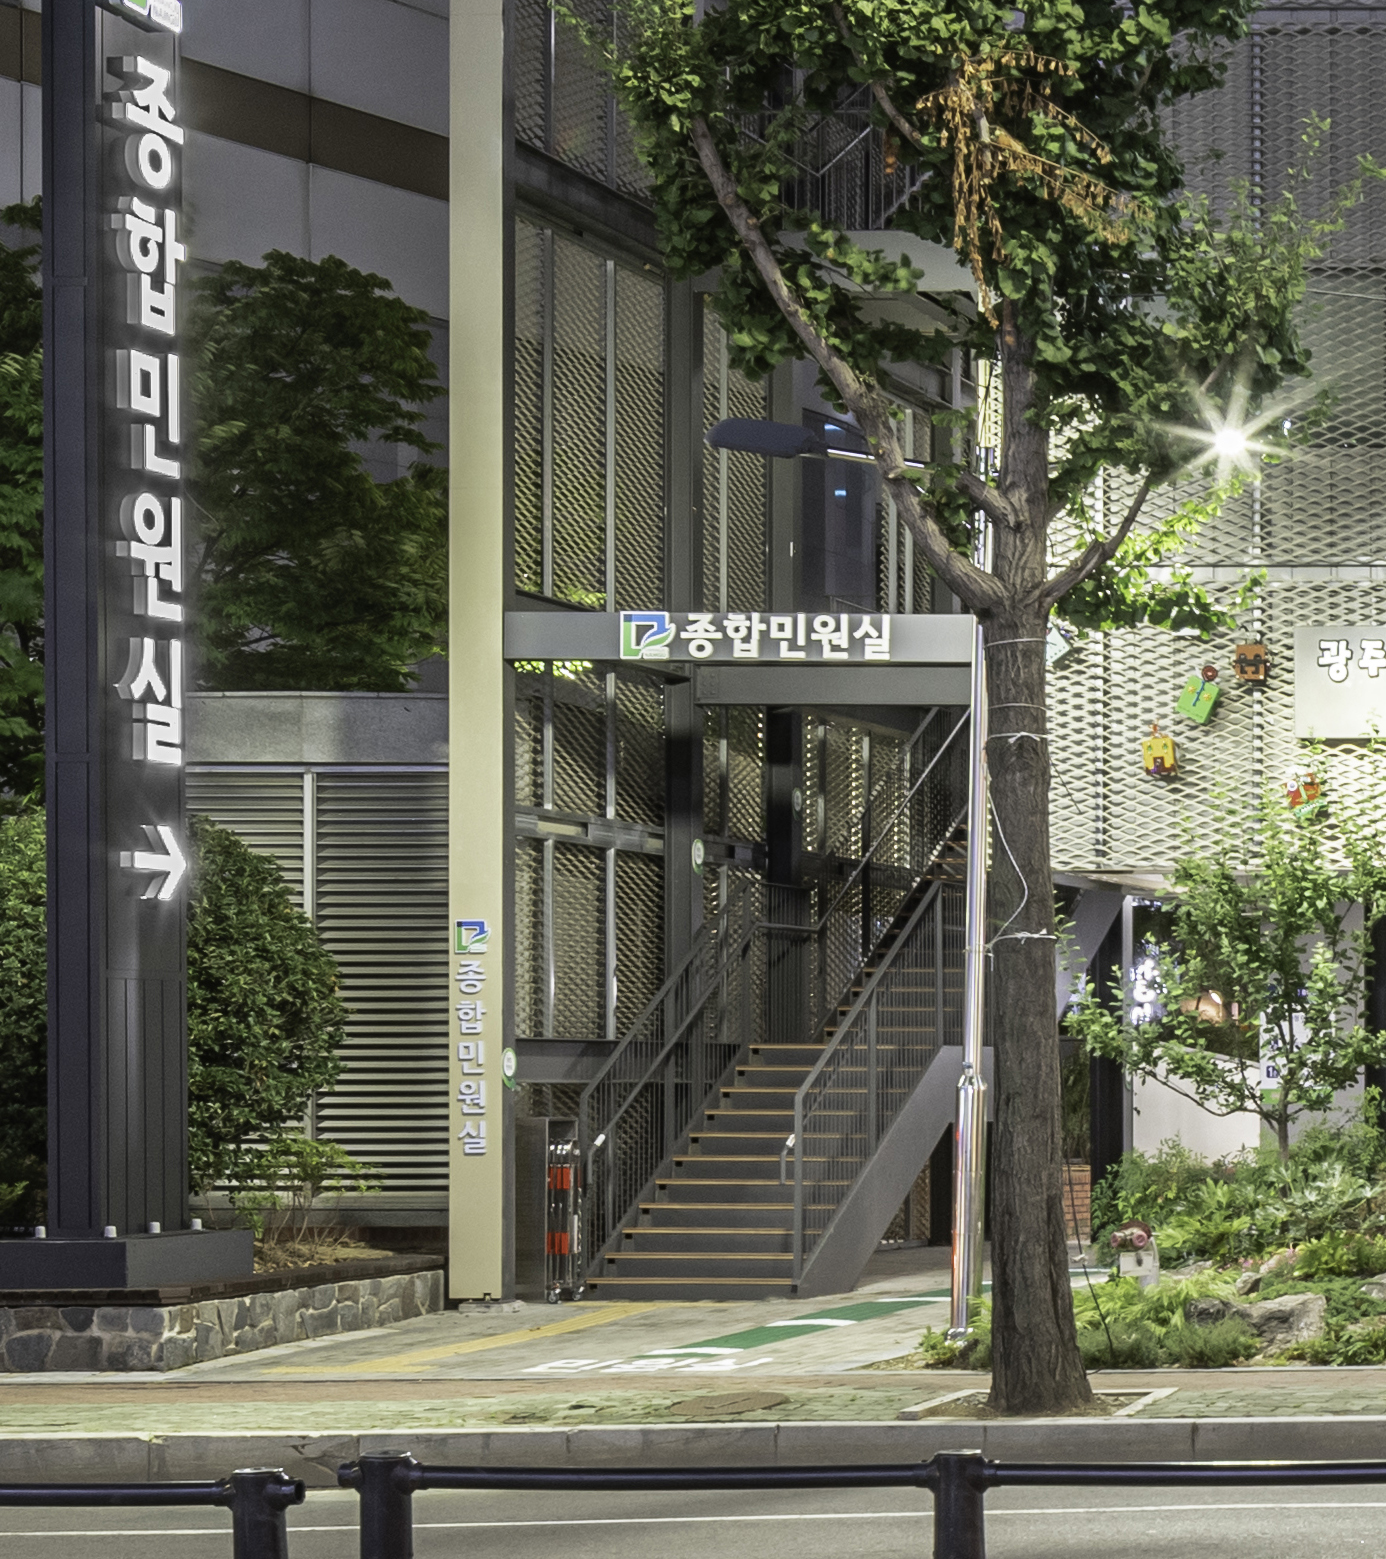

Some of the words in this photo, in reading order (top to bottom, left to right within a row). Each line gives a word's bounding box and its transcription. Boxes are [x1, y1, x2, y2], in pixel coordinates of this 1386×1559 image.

[122, 53, 187, 767] 종합민원실
[679, 611, 892, 661] 종합민원실
[454, 959, 488, 1156] 종합민원실
